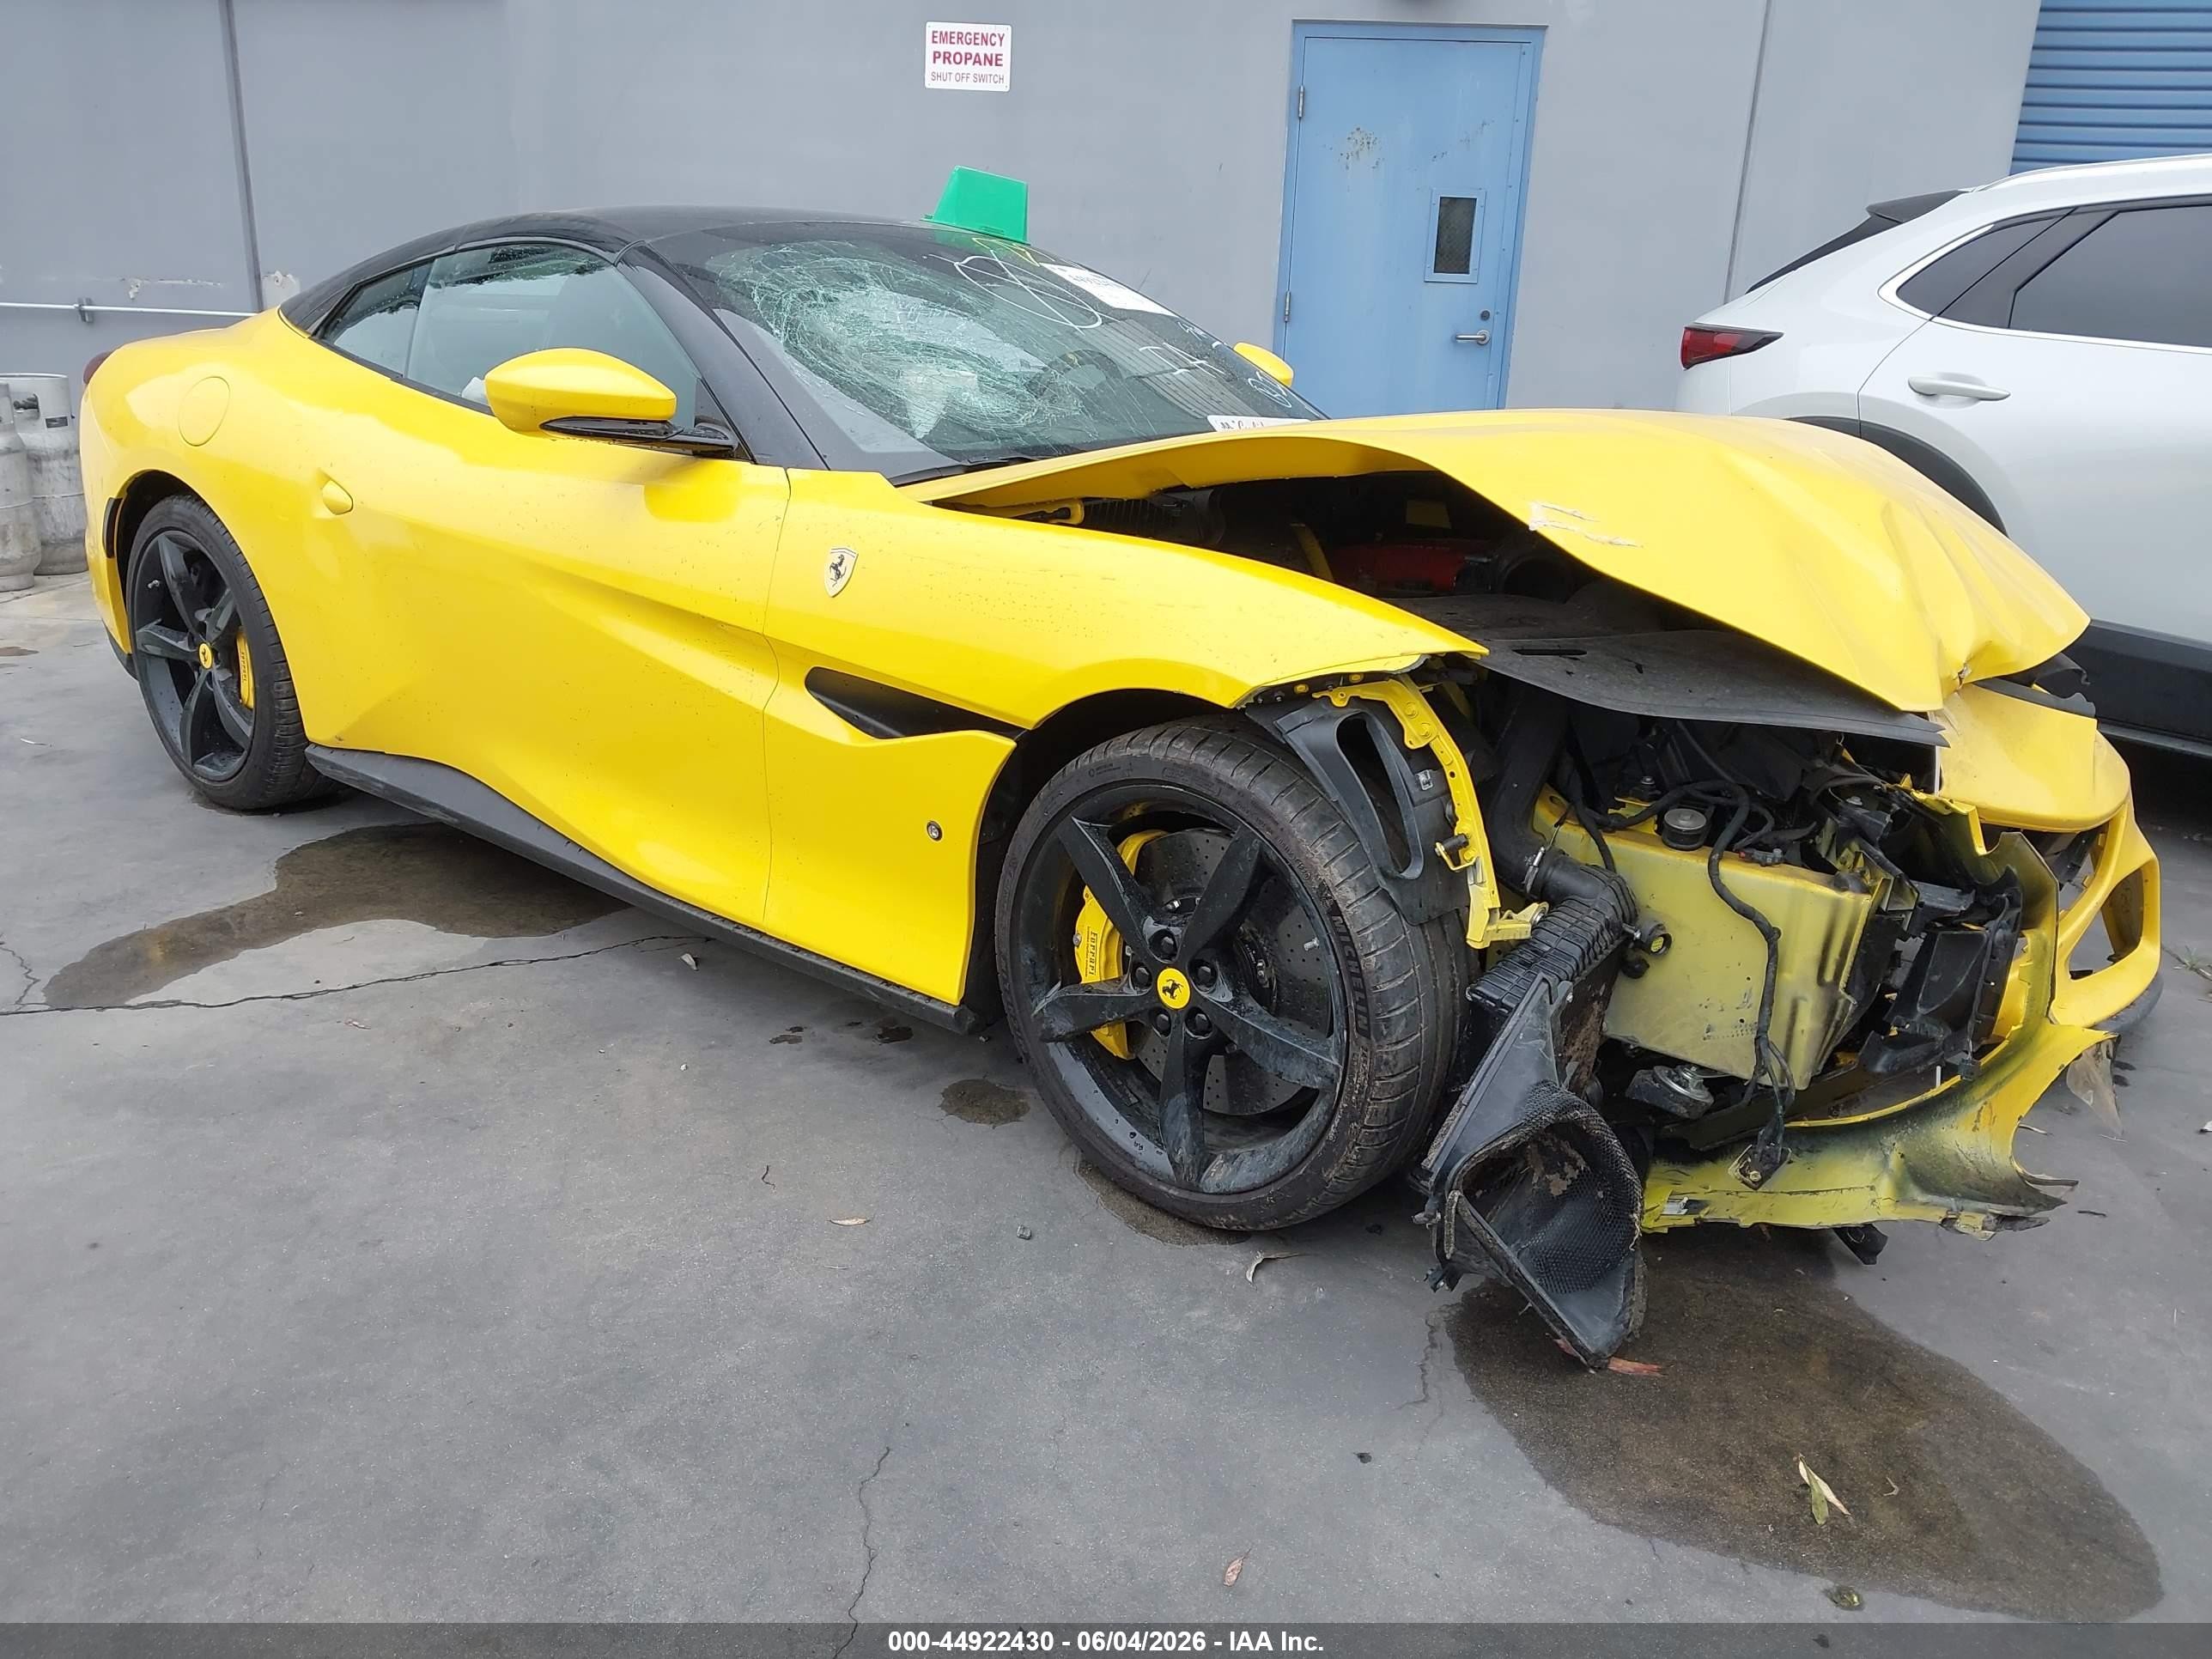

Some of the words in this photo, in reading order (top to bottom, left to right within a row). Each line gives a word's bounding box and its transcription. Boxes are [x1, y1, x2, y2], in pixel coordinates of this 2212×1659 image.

[931, 30, 1005, 47] EMERGENCY
[933, 51, 1004, 67] PROPANE
[931, 71, 952, 82] SHUT
[955, 72, 970, 82] OFF
[972, 73, 1005, 84] SWITCH
[1088, 931, 1098, 976] Ferrari
[1331, 915, 1369, 1034] MICHELIN
